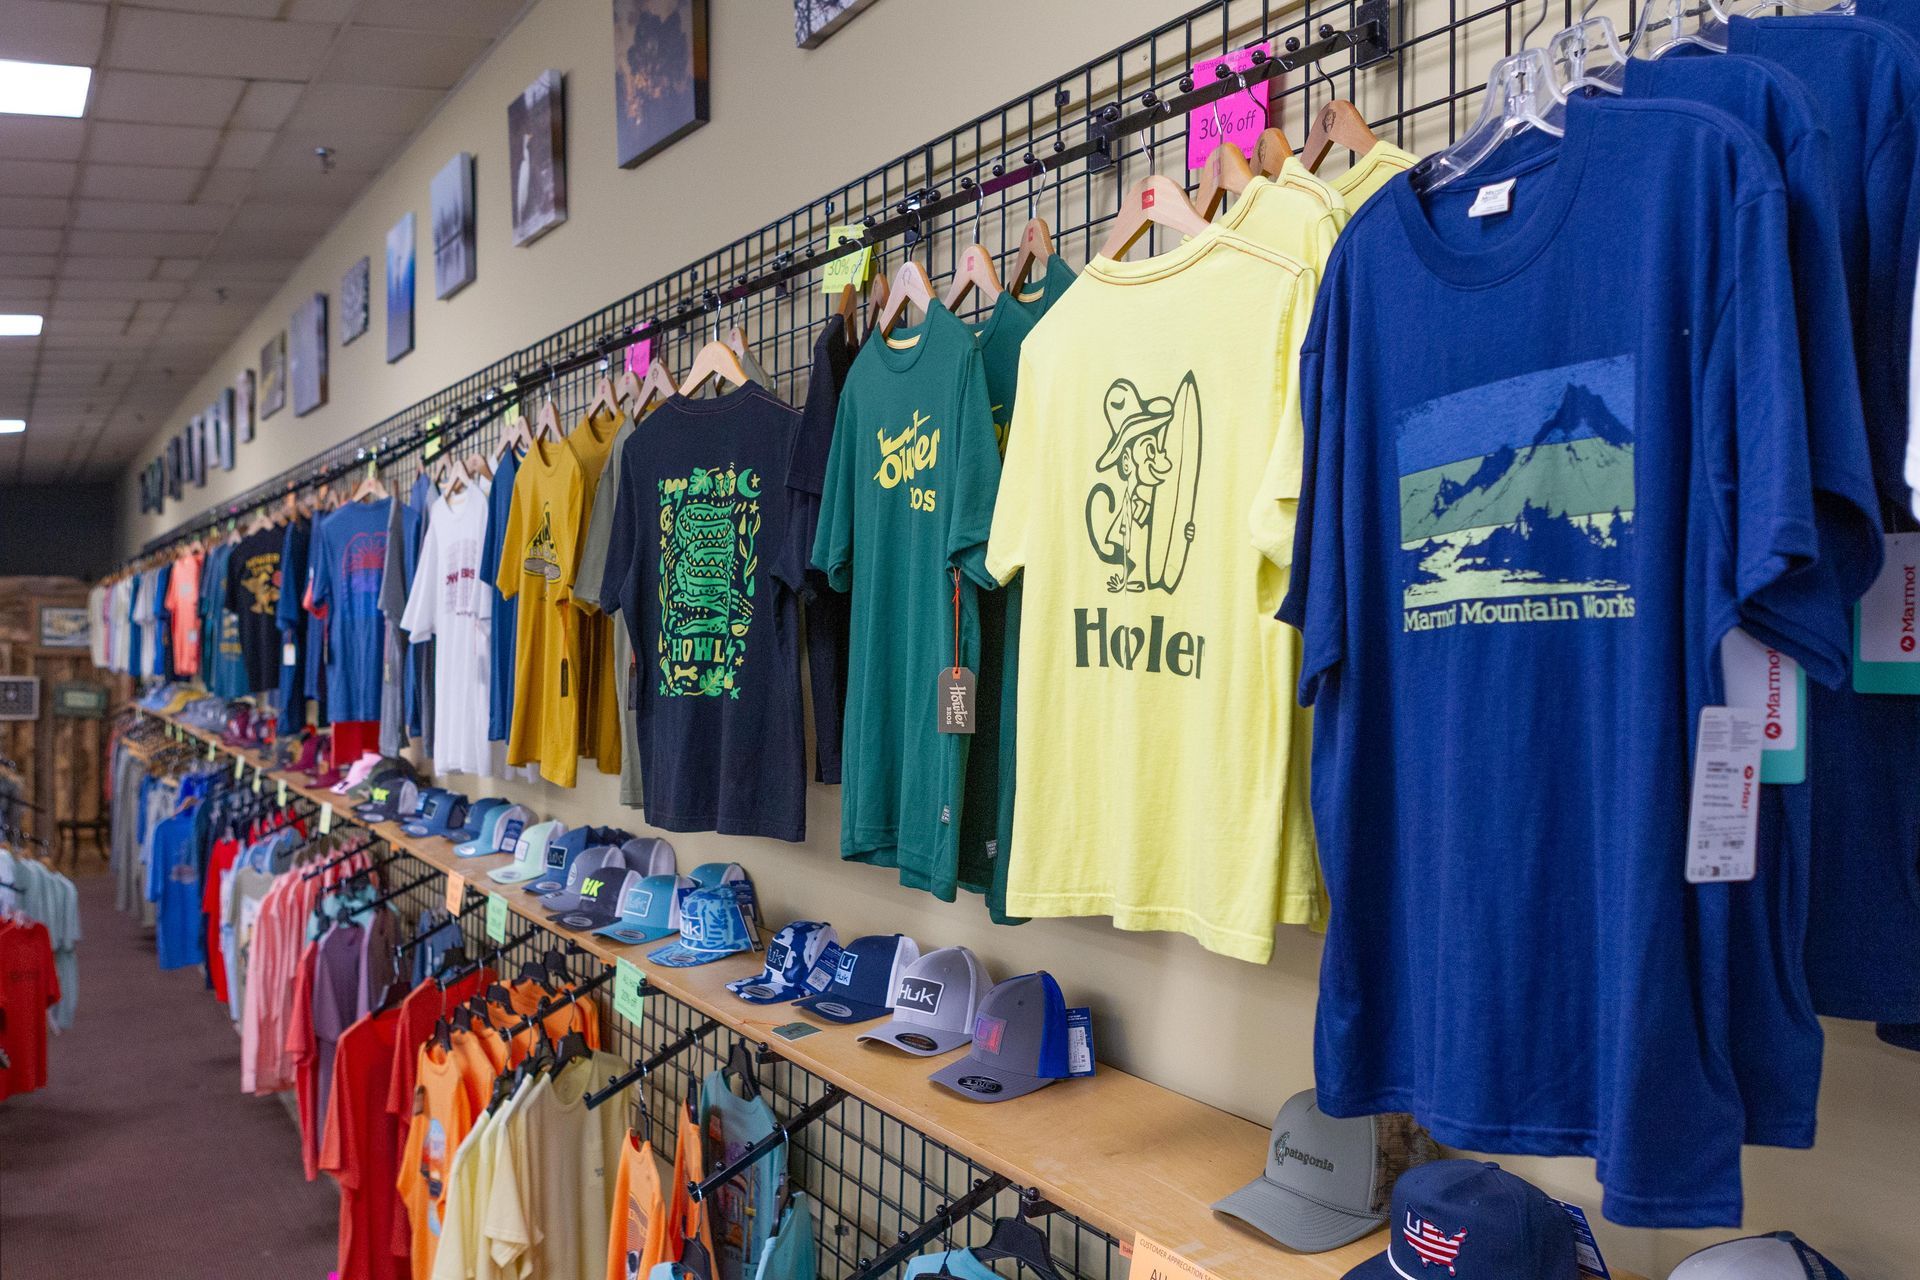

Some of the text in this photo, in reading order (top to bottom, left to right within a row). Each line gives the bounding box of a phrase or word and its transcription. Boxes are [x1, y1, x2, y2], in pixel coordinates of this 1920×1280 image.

[1199, 109, 1257, 140] 30% off
[1460, 598, 1580, 625] Mountain
[1582, 593, 1636, 619] Works
[672, 637, 726, 664] HOWL
[1284, 1146, 1336, 1174] patagonia
[1139, 1237, 1168, 1260] CUSTOMER
[1167, 1255, 1206, 1280] APPRECIATION
